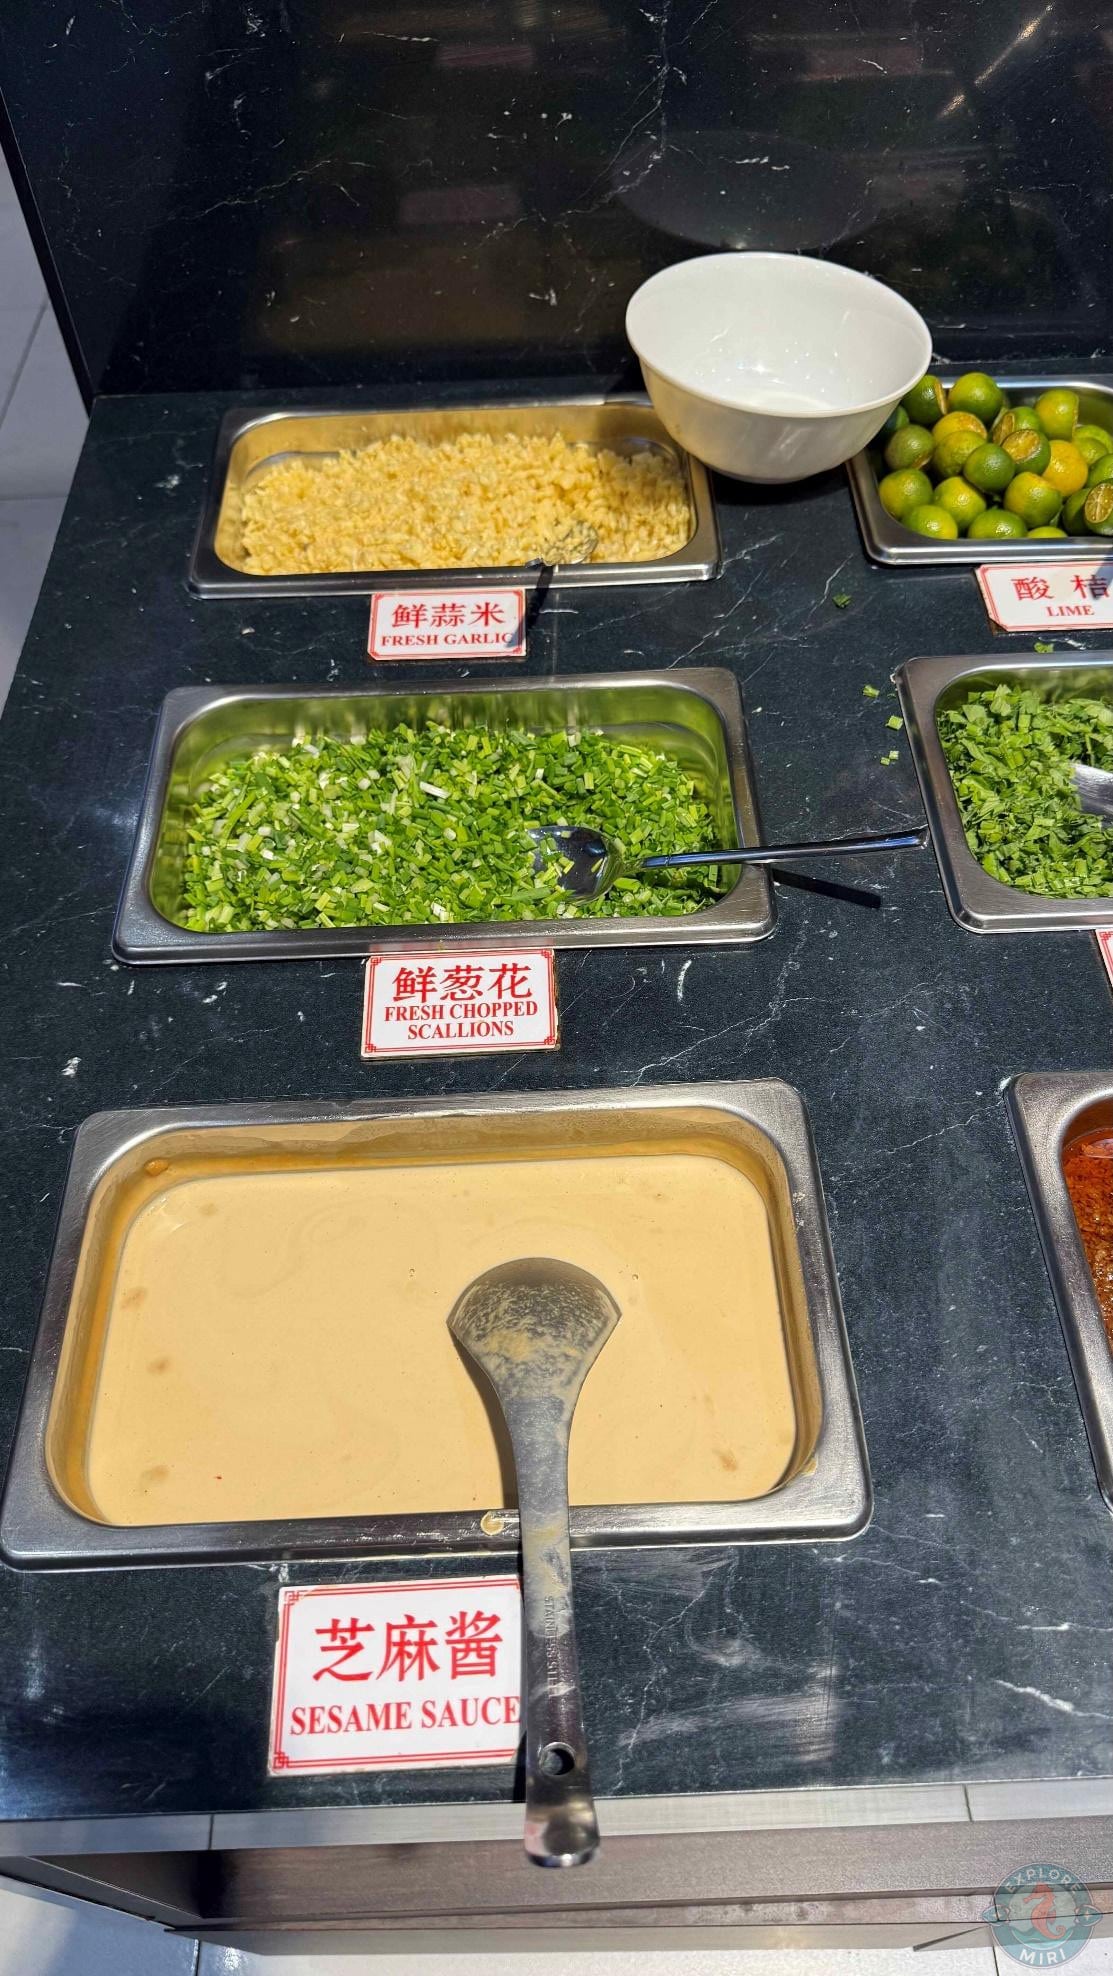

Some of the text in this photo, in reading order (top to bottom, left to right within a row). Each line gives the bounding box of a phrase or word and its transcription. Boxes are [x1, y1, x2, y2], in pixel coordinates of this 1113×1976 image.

[391, 601, 505, 629] 鲜蒜米
[1046, 604, 1094, 617] LIME
[381, 632, 513, 647] FRESH GARLIC
[392, 963, 532, 1003] 鲜葱花
[384, 1001, 538, 1022] FRESH CHOPPED
[407, 1020, 514, 1040] SCALLIONS
[312, 1610, 503, 1682] 芝麻酱
[289, 1696, 520, 1736] SESAME SAUCE
